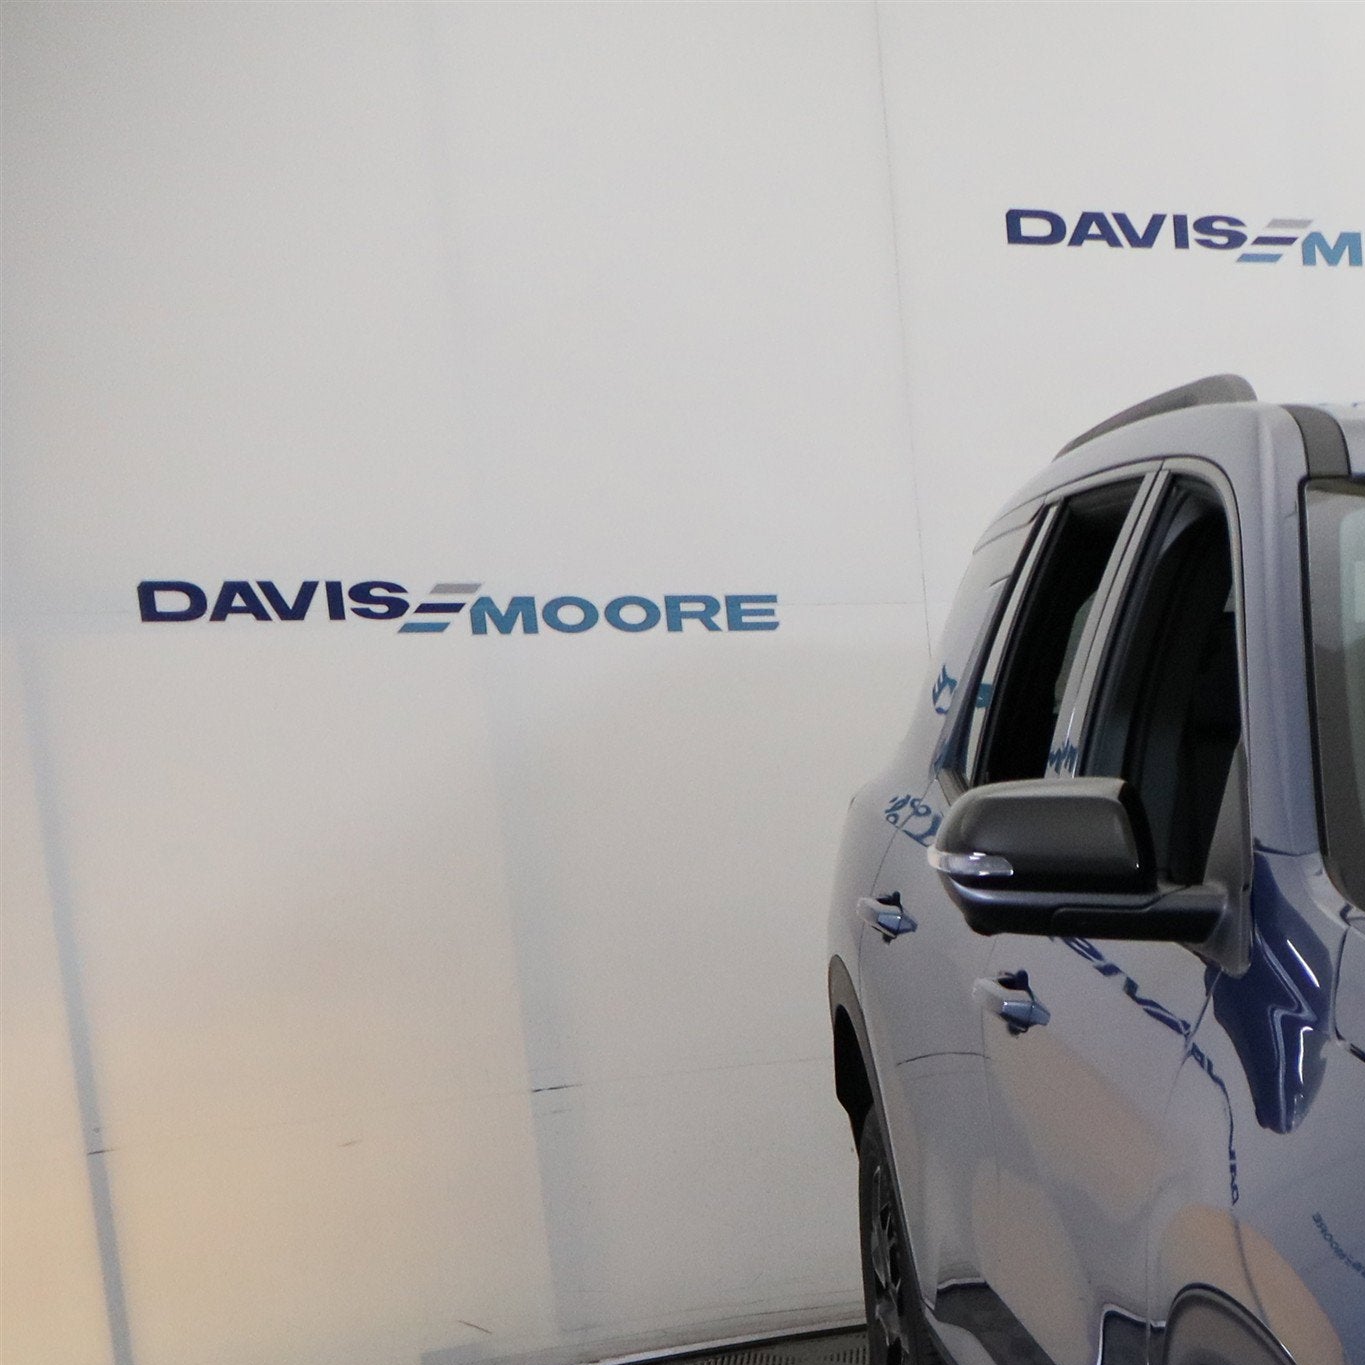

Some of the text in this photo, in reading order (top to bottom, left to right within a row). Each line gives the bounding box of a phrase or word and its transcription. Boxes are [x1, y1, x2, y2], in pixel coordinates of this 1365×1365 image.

[1004, 207, 1249, 251] DAVIS
[135, 579, 781, 636] DAVIS MOORE
